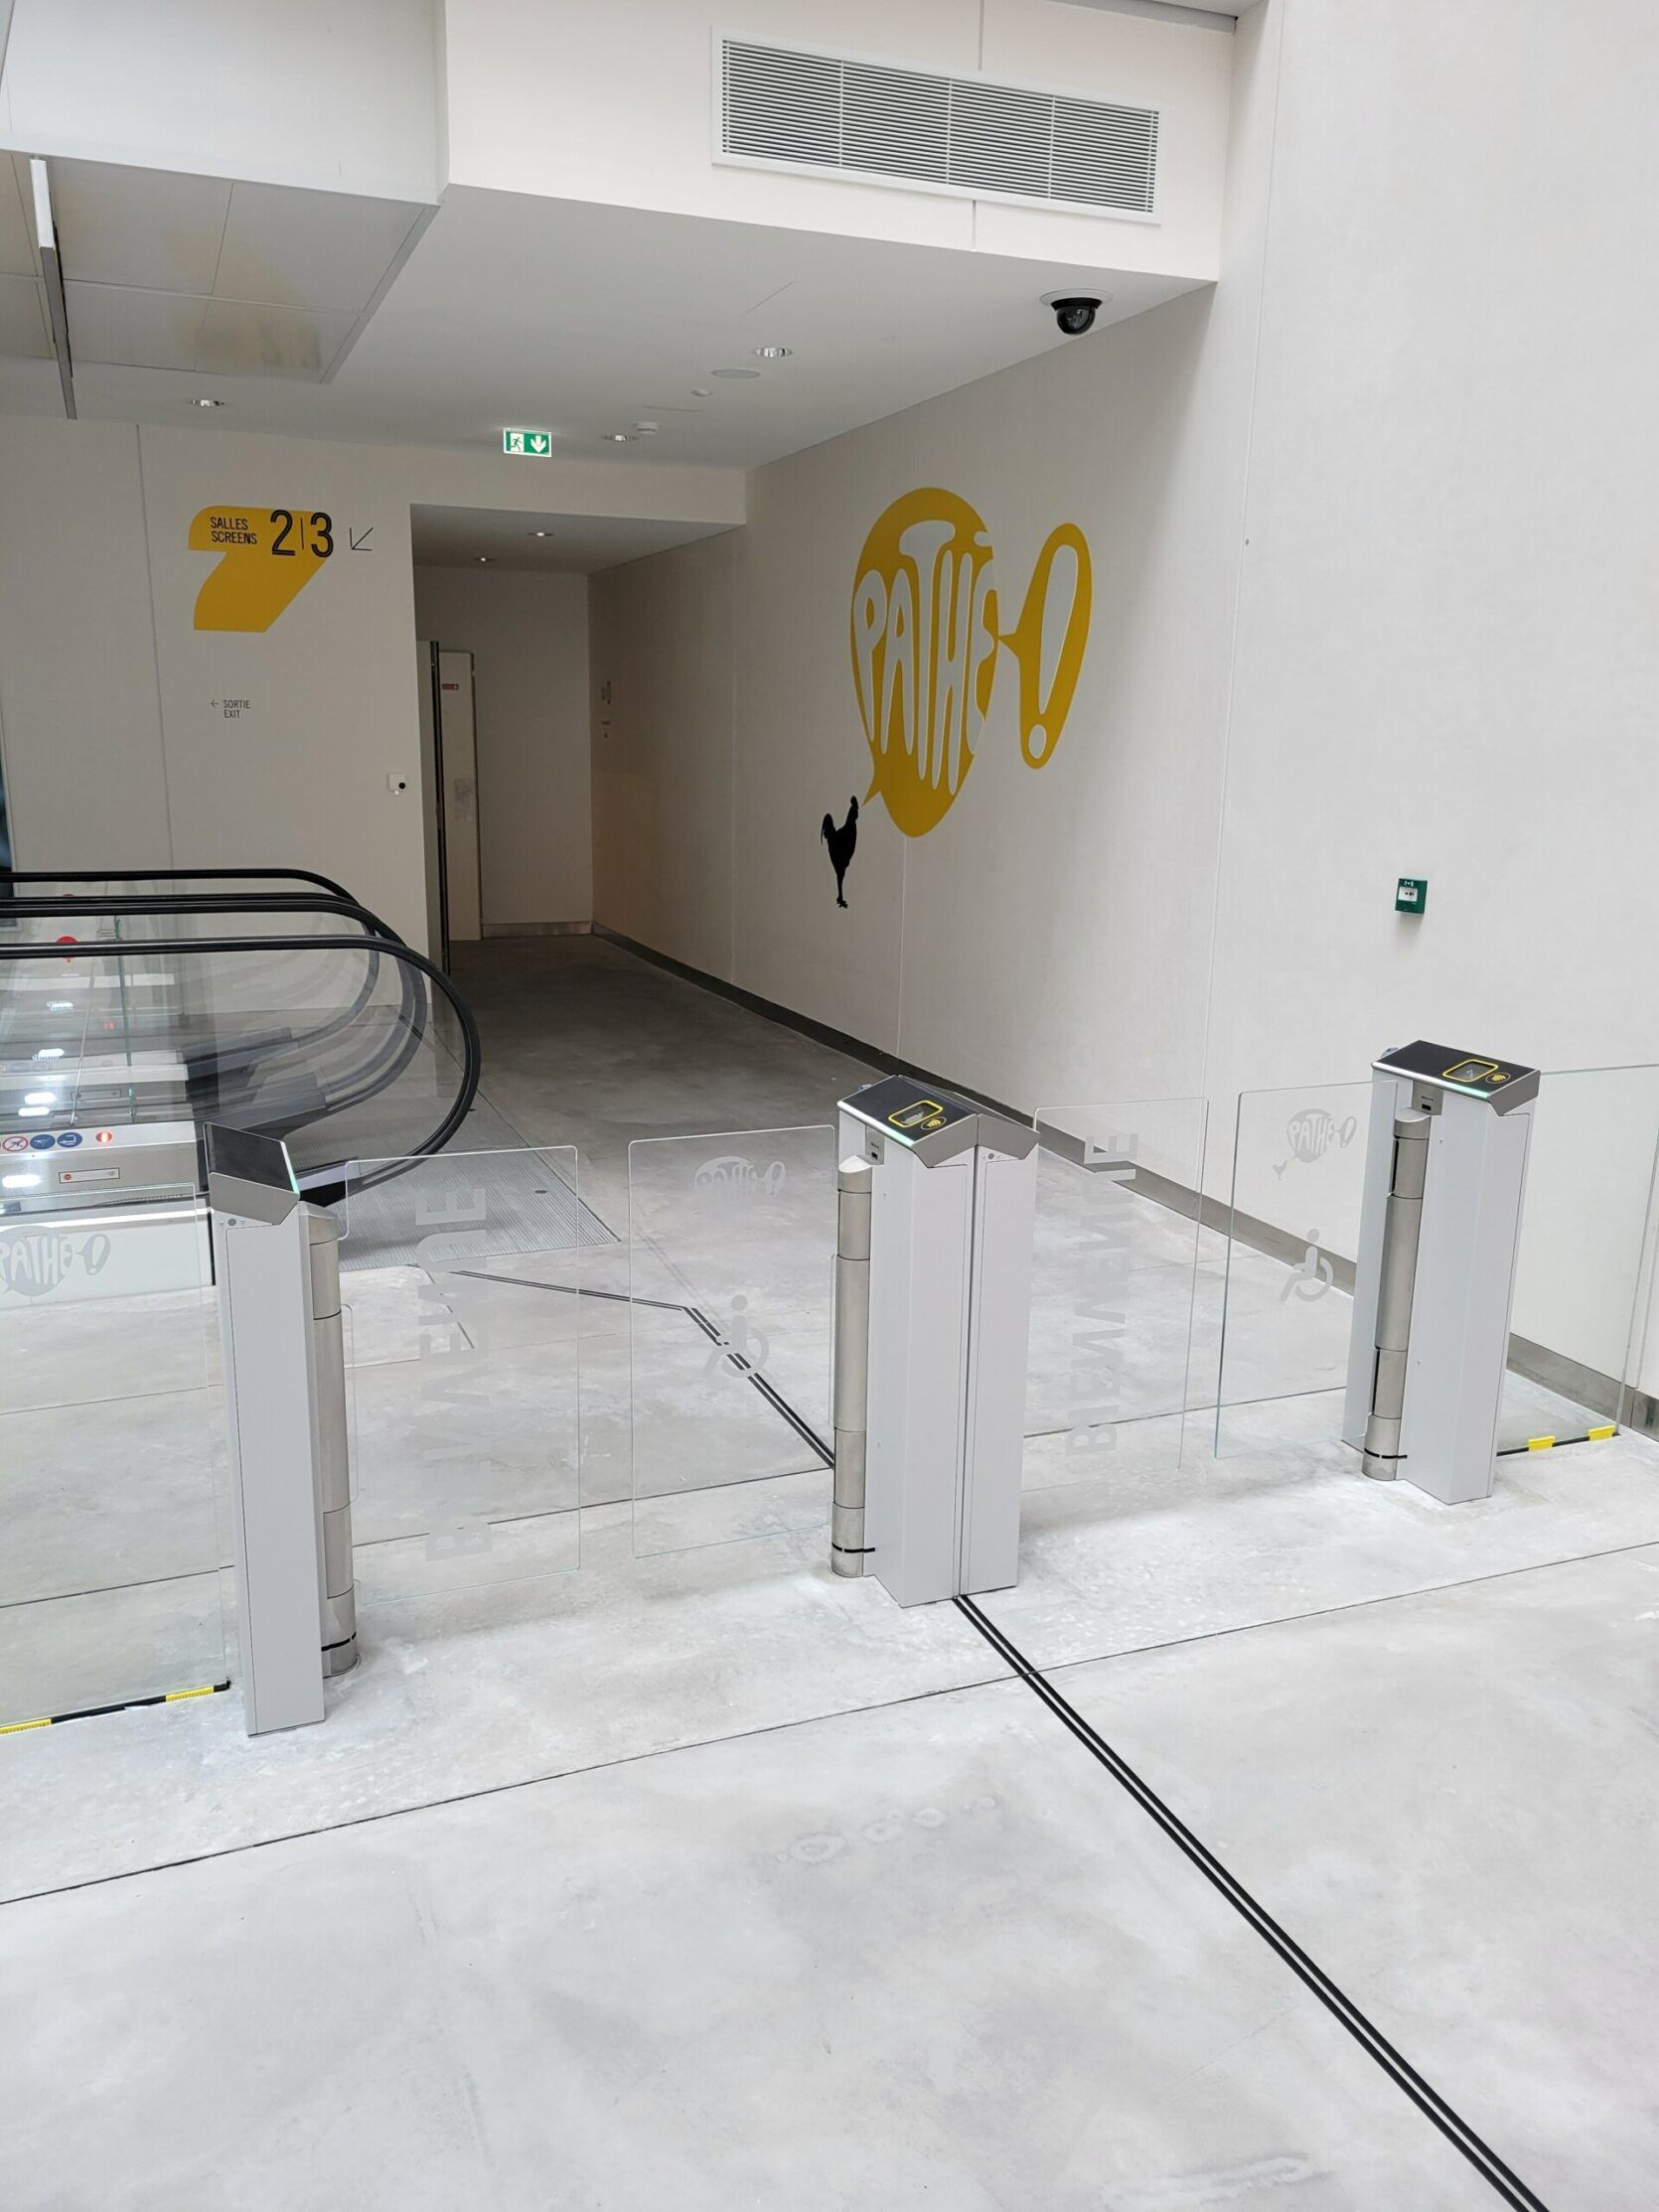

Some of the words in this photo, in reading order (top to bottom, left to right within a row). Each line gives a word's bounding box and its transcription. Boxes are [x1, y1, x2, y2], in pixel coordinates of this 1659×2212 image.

[210, 516, 248, 530] SALLES
[211, 530, 258, 545] SCREENS
[223, 699, 251, 709] SORTIE
[224, 709, 240, 719] EXIT
